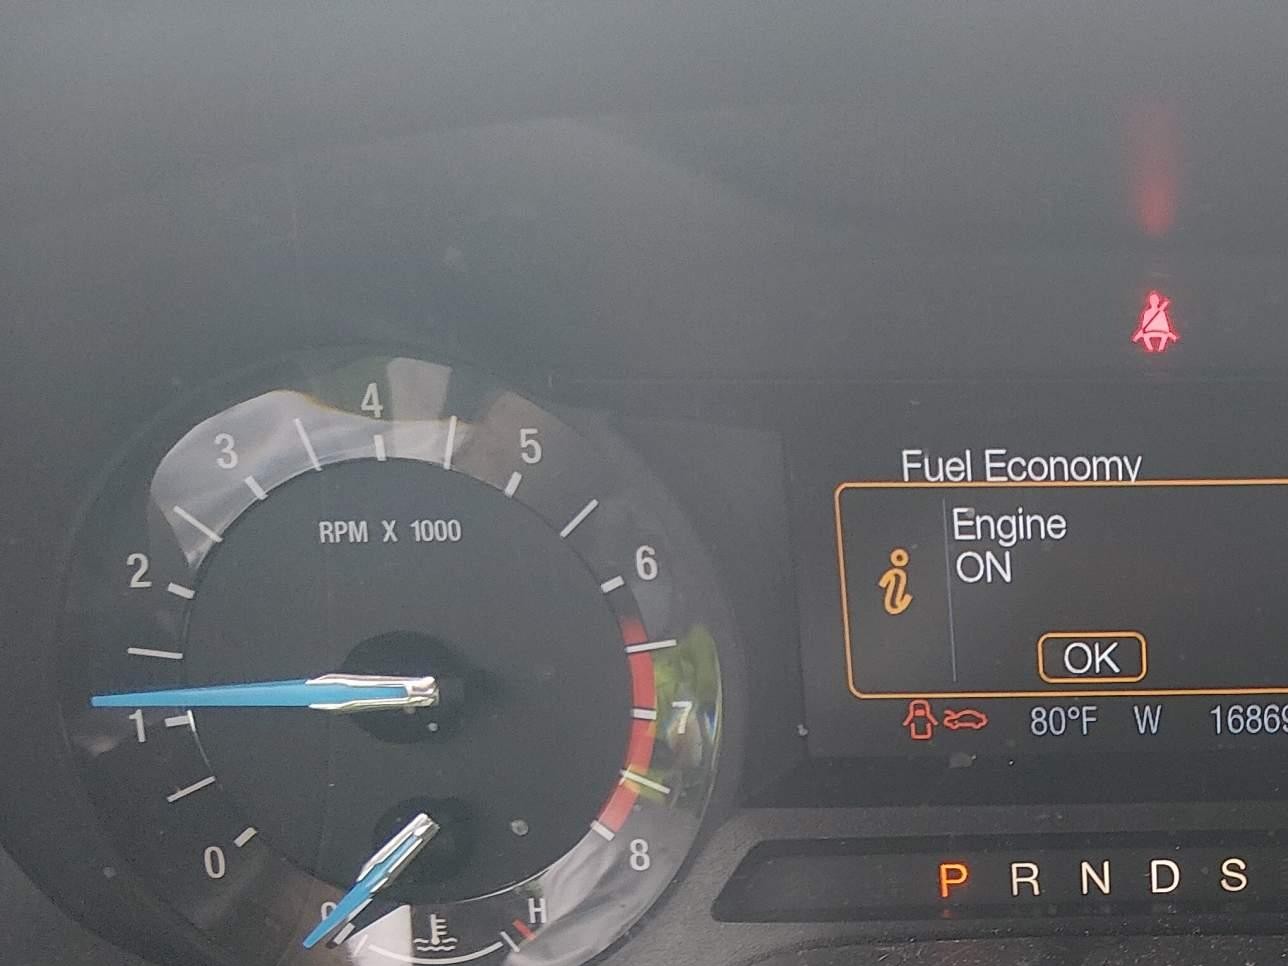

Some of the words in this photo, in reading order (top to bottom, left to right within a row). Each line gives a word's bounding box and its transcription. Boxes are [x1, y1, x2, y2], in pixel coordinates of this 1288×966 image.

[360, 384, 383, 418] 4
[214, 433, 238, 469] 3
[519, 429, 541, 462] 5
[901, 450, 972, 482] Fuel
[984, 450, 1142, 482] Economy
[319, 520, 368, 543] RPM
[382, 521, 398, 542] X
[410, 519, 462, 542] 1000
[953, 508, 1067, 545] Engine
[126, 553, 152, 588] 2
[635, 546, 658, 579] 6
[956, 552, 1012, 583] ON
[1064, 642, 1120, 674] OK
[129, 710, 146, 742] 1
[671, 701, 692, 734] 7
[1030, 706, 1097, 736] 80°F
[1134, 706, 1162, 734] W
[204, 846, 226, 878] 0
[629, 839, 650, 870] 8
[940, 863, 968, 897] P
[1011, 862, 1040, 896] R
[1081, 861, 1110, 894] N
[1151, 860, 1180, 892] D
[1221, 859, 1248, 892] S
[528, 898, 547, 923] H
